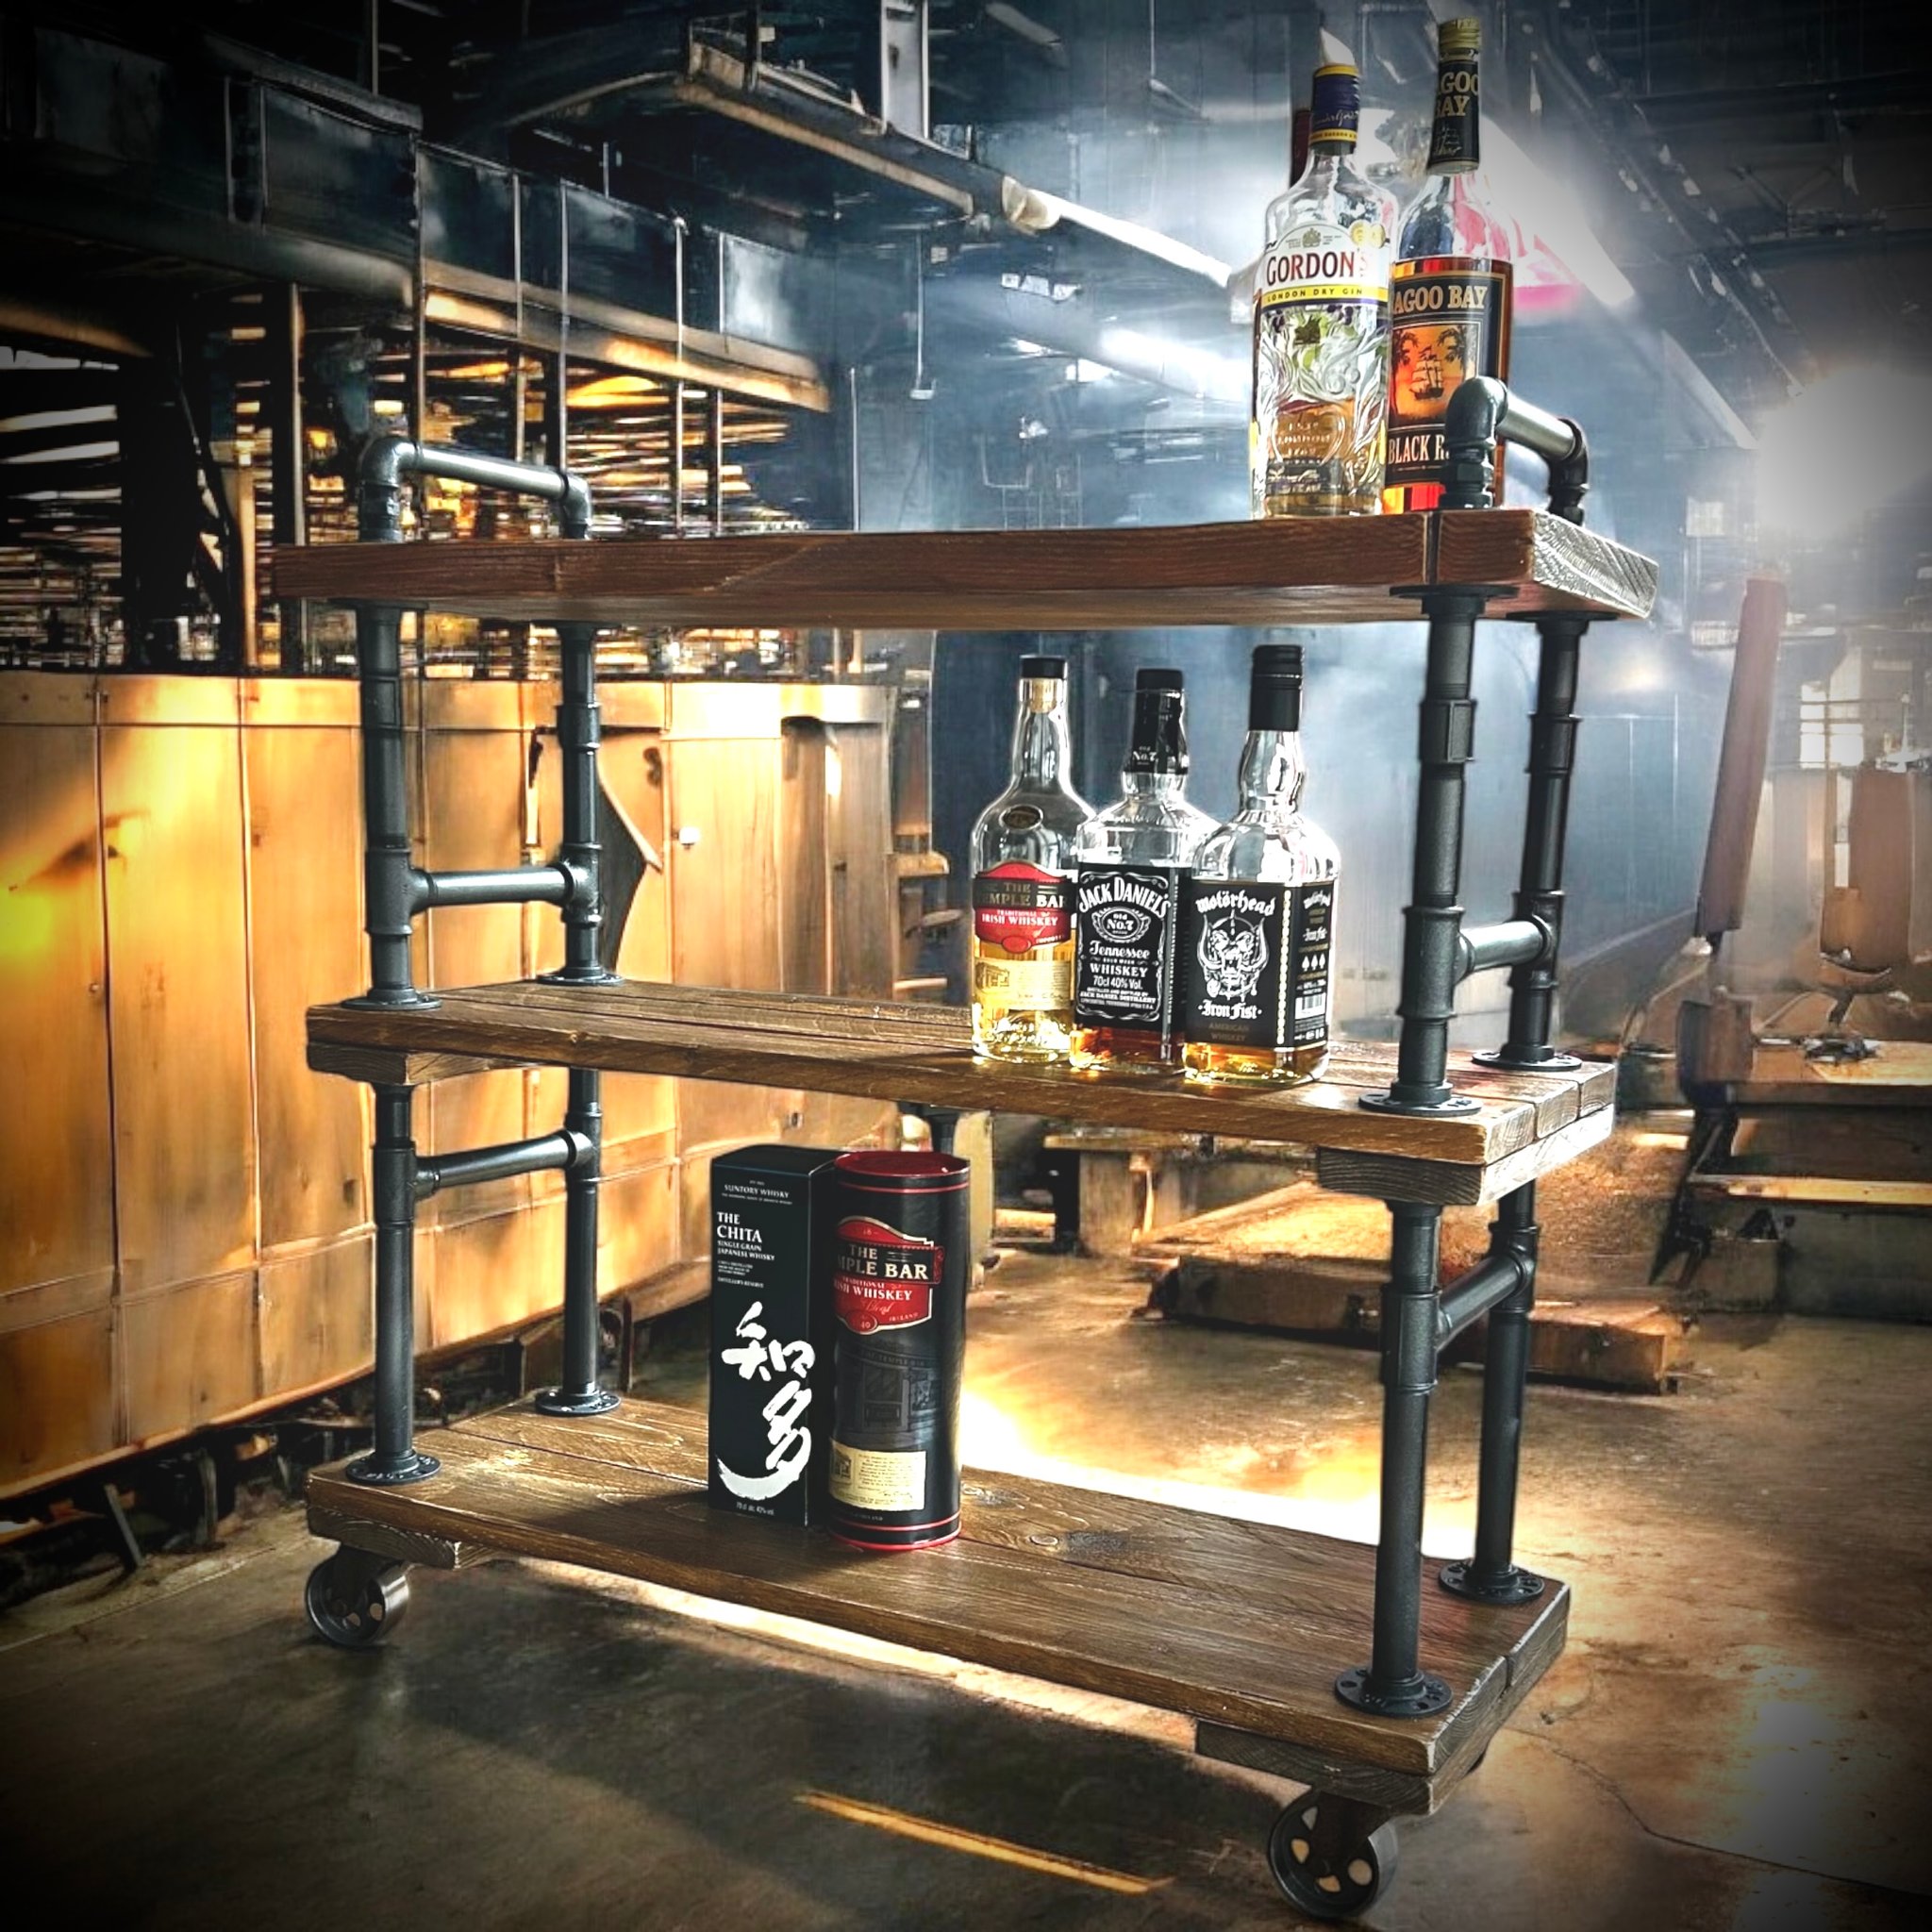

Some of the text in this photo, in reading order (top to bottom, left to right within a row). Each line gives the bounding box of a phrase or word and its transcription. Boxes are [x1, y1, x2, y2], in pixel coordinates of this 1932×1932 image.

[1267, 289, 1307, 302] LONDON
[1447, 285, 1488, 309] BAY
[1388, 434, 1450, 465] BLACK R
[1003, 881, 1031, 893] THE
[1078, 875, 1172, 919] JACK DANIEL'S
[981, 913, 1058, 926] IRISH WHISKEY
[1107, 918, 1135, 931] No.7
[1089, 940, 1151, 959] Tennessee
[1090, 962, 1149, 978] WHISKEY
[1110, 976, 1128, 989] 40%
[1095, 992, 1119, 1001] DANIEL
[724, 1183, 758, 1195] SUNTORY
[759, 1188, 790, 1199] WHISKY
[717, 1211, 740, 1224] THE
[717, 1224, 762, 1243] CHITA
[718, 1240, 762, 1252] SINGLE GRAIN
[850, 1244, 878, 1260] THE
[748, 1252, 775, 1260] WHISKY
[884, 1262, 929, 1280] BAR
[852, 1285, 913, 1301] WHISKEY
